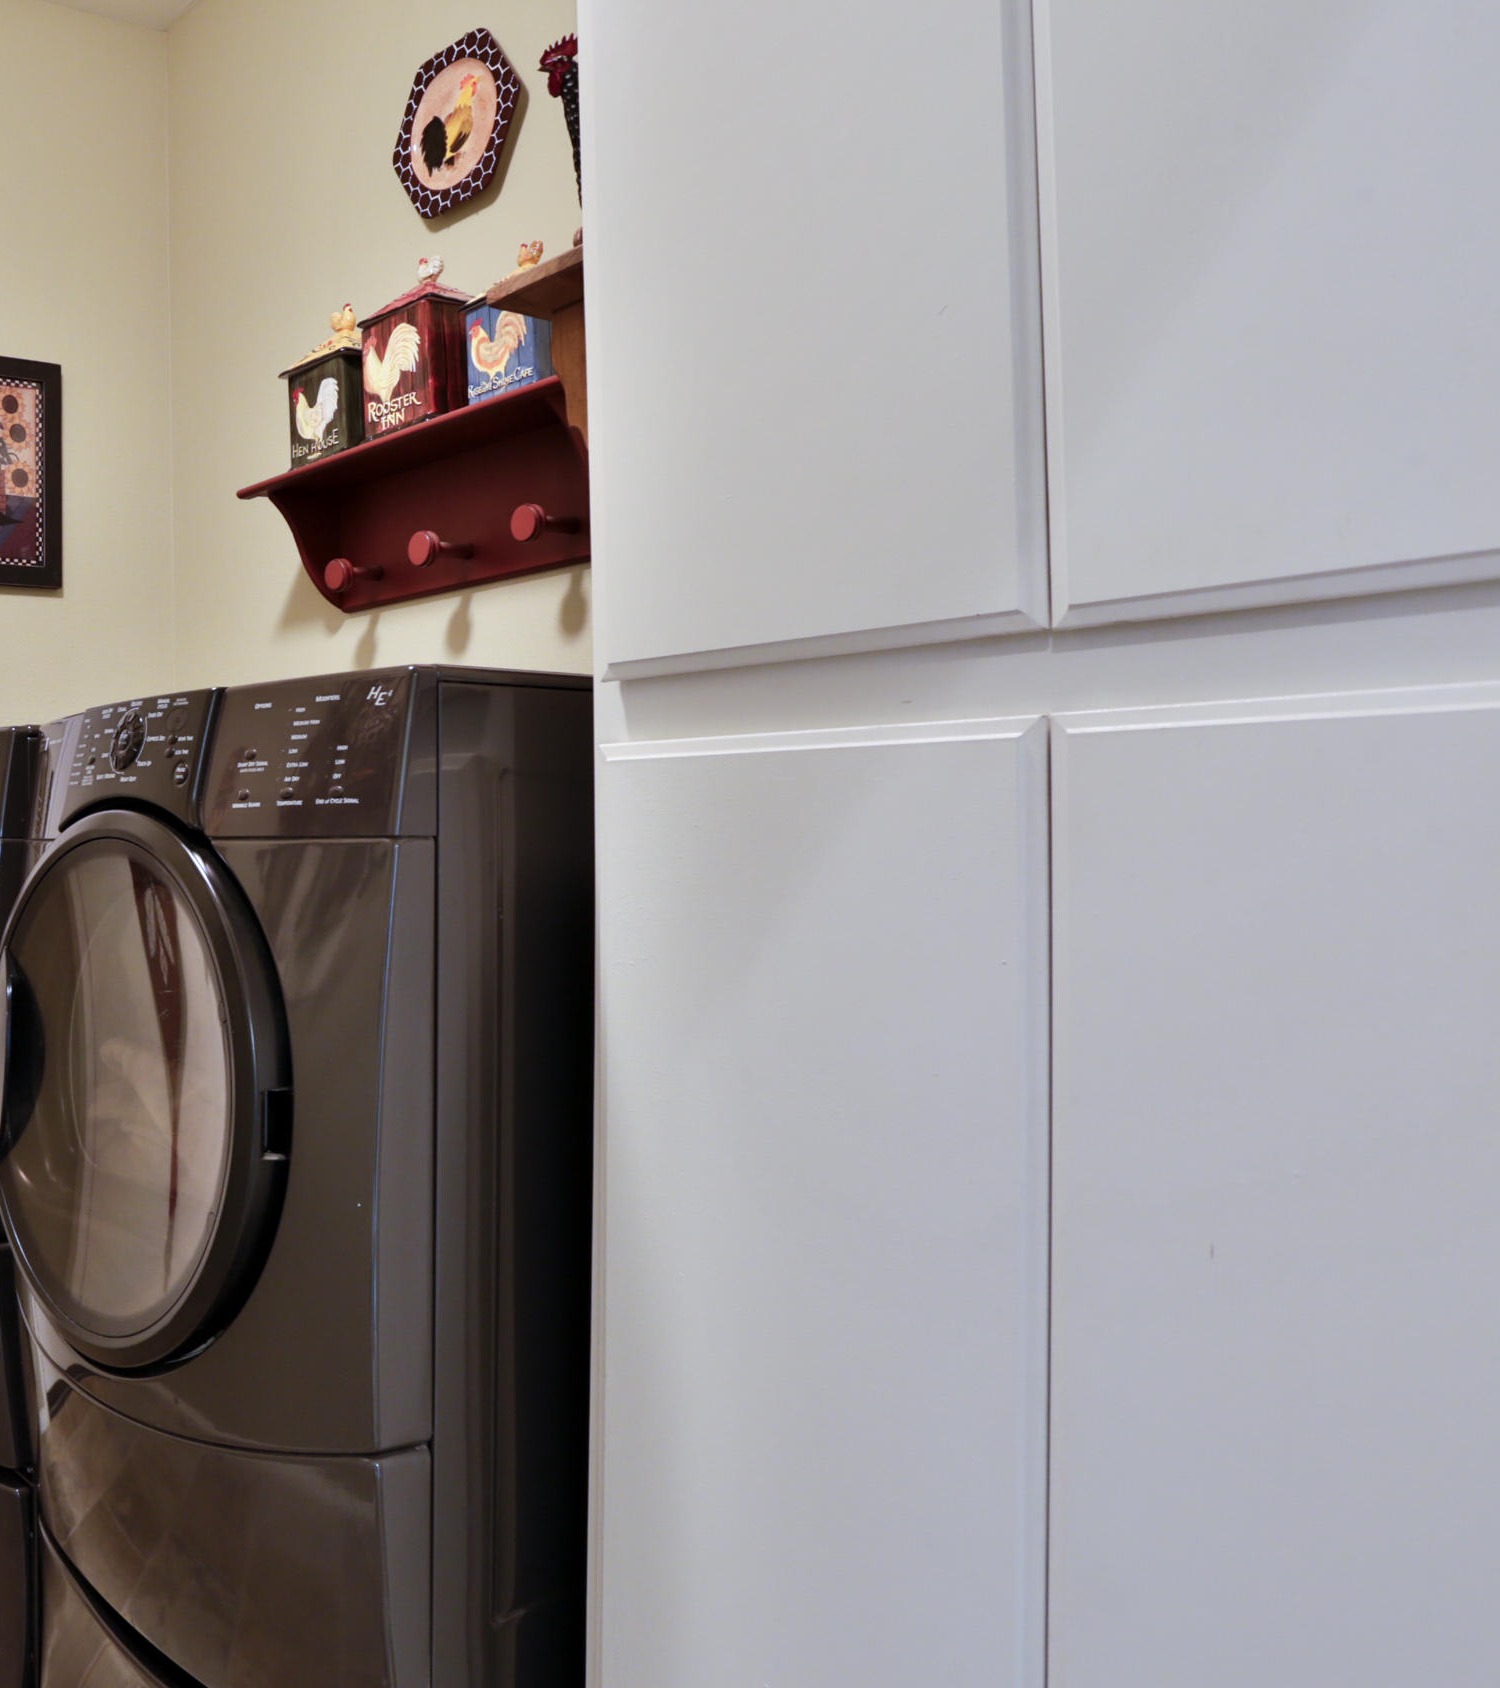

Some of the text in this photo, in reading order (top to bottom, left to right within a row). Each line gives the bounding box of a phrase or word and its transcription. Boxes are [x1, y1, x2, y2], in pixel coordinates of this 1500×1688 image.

[368, 391, 422, 423] ROOSTER
[380, 407, 405, 430] INN
[292, 428, 339, 459] HEN HOUSE
